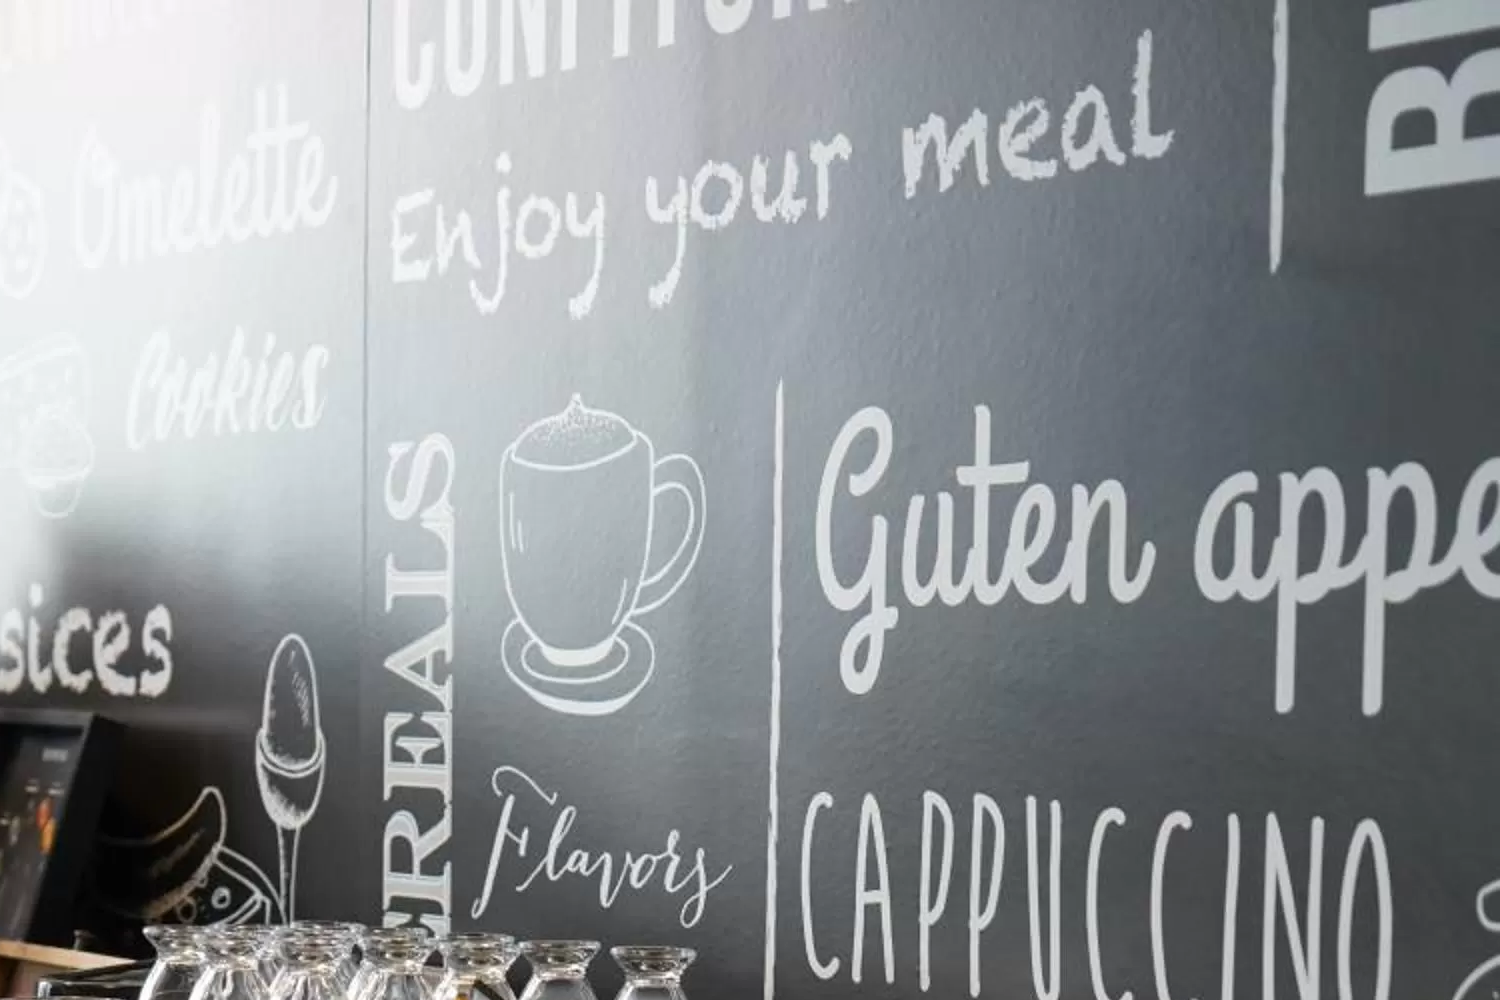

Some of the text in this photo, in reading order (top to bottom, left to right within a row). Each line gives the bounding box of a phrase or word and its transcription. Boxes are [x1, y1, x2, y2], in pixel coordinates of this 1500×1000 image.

[73, 80, 339, 270] Omelette
[390, 151, 606, 320] Enjoy
[645, 133, 853, 309] your
[902, 29, 1175, 199] meal
[125, 325, 330, 452] Cookies
[815, 405, 1157, 694] Guten
[471, 765, 733, 929] Flavors
